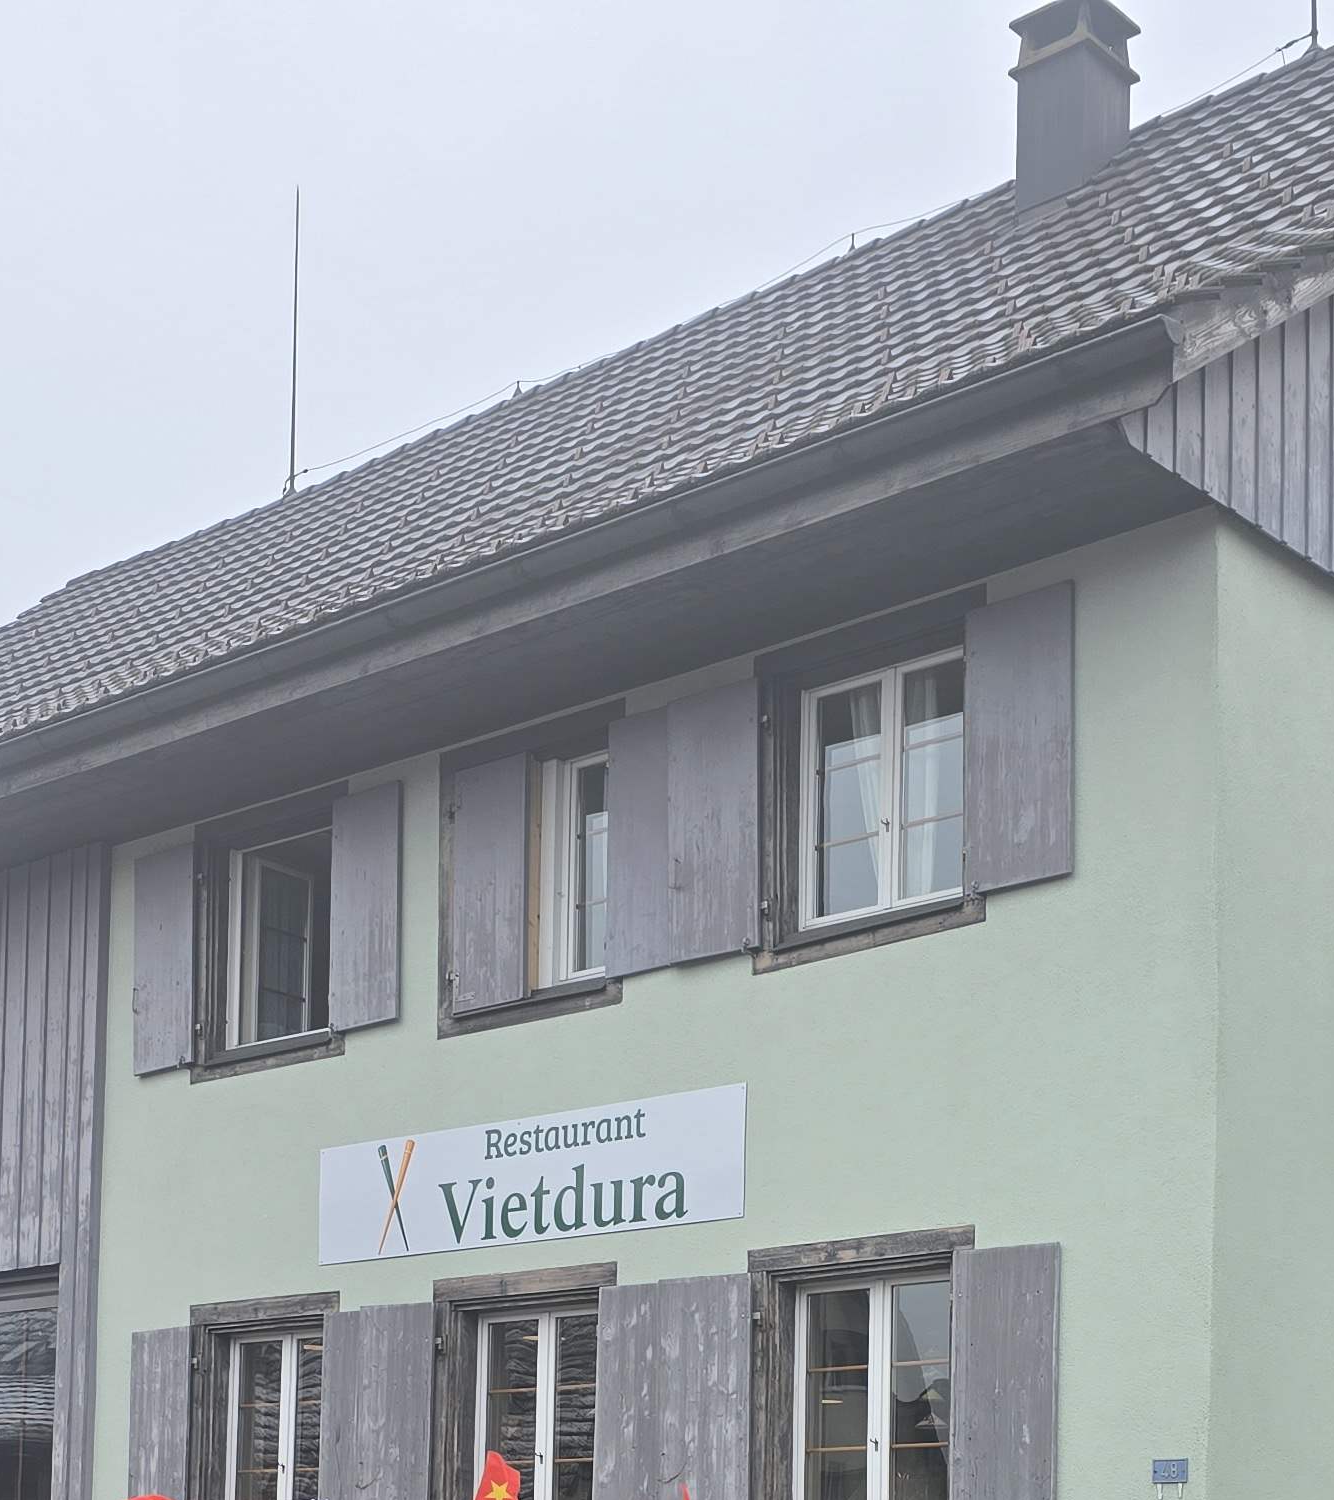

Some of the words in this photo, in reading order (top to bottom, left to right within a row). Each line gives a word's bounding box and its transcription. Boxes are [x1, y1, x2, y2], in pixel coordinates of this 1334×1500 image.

[484, 1108, 646, 1160] Restaurant
[438, 1164, 688, 1244] Vietdura
[1160, 1461, 1179, 1479] 48
